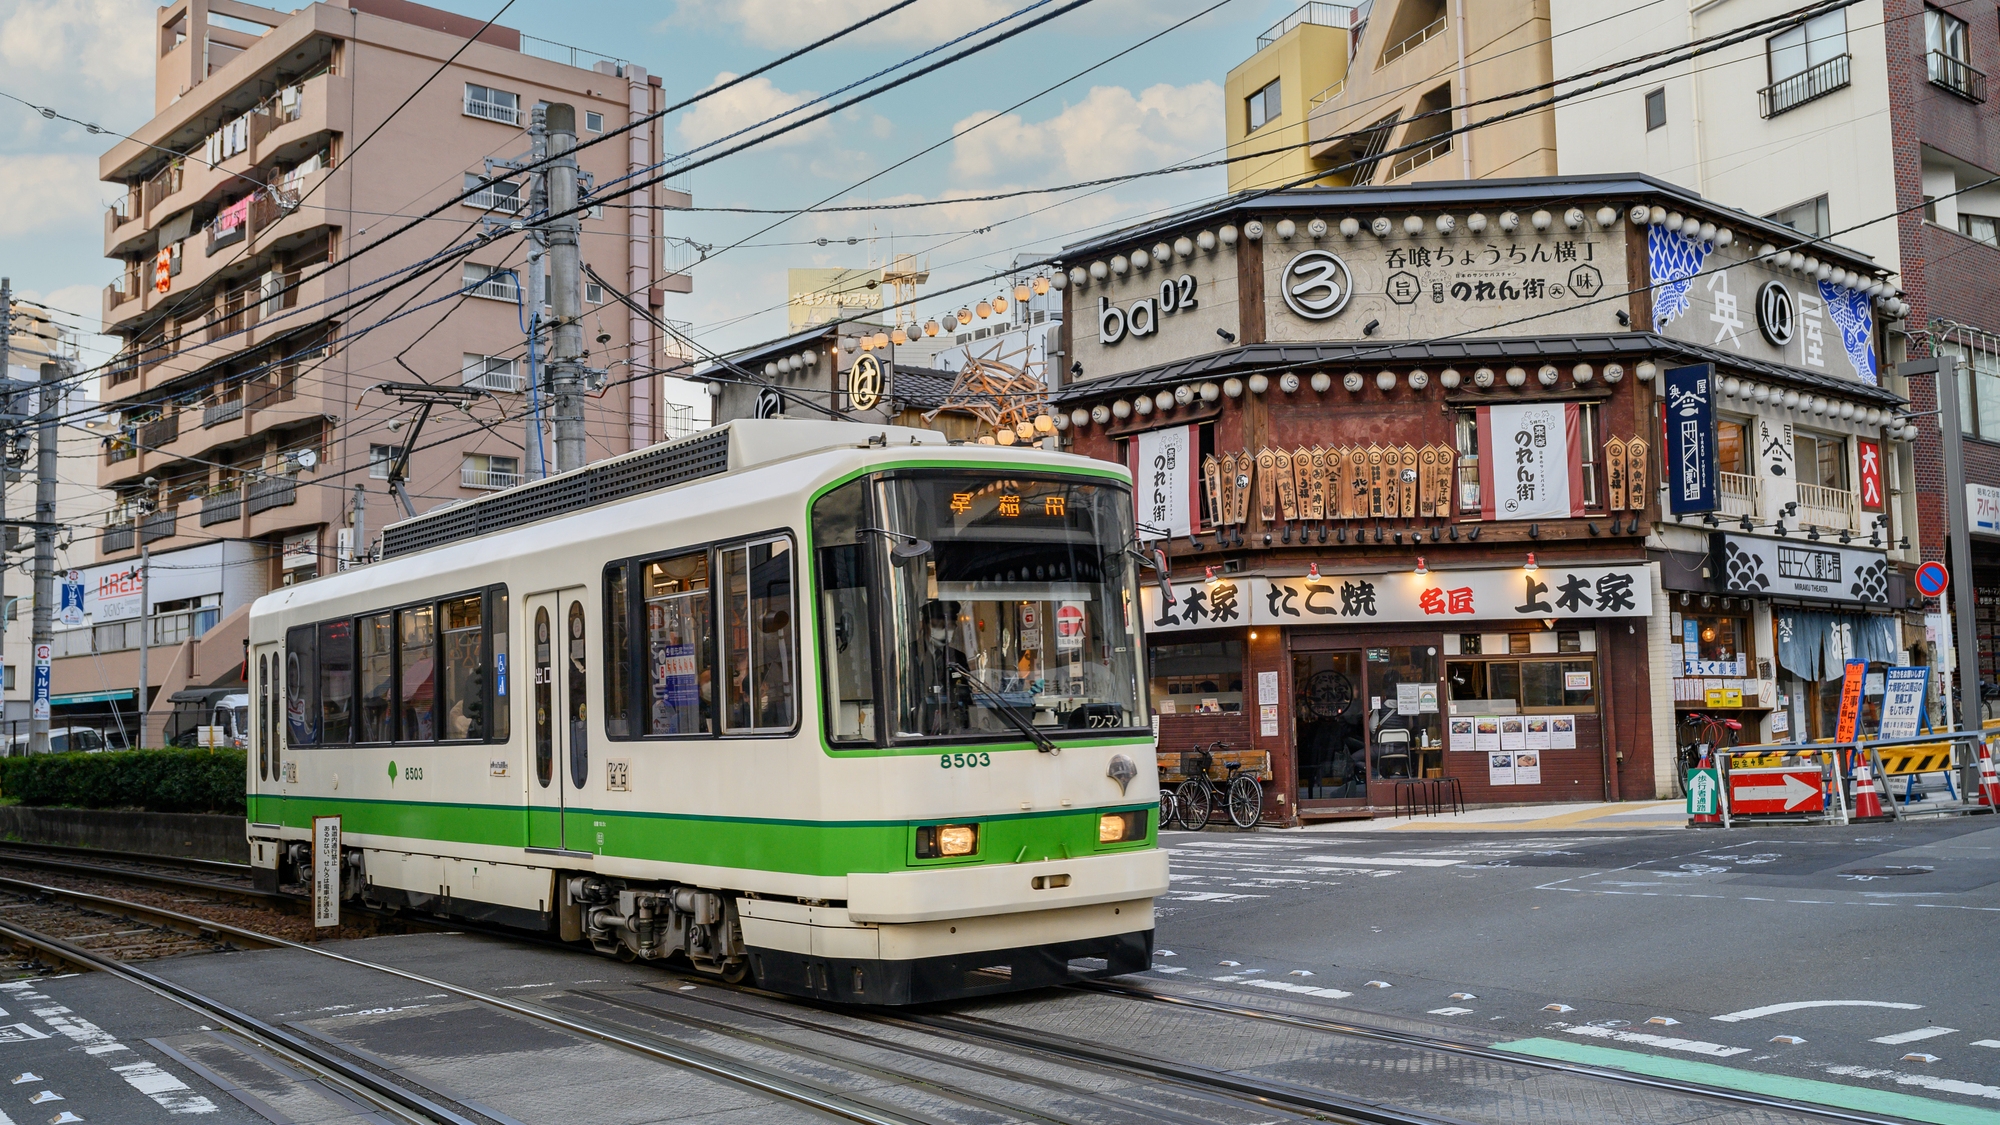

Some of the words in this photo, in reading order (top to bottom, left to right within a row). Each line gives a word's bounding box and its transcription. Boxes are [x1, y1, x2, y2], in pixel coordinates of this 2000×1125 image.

[1385, 241, 1601, 268] 呑喰ちょうちん横丁
[1394, 280, 1411, 297] 旨
[1451, 278, 1545, 301] のれん街
[1576, 272, 1594, 290] 味
[852, 358, 879, 406] は
[1515, 431, 1535, 501] のれん街
[1153, 455, 1166, 522] のれん街
[68, 585, 78, 606] マルヨ
[1266, 580, 1378, 617] たこ焼
[1419, 586, 1476, 615] 名匠
[1514, 573, 1636, 613] 上木家
[1794, 583, 1811, 591] MIRAKU
[1811, 584, 1829, 593] THEATER
[1154, 584, 1240, 627] 上木家
[1831, 621, 1853, 660] 酒
[536, 667, 552, 684] 出口
[1685, 661, 1737, 675] みらく劇場
[37, 666, 49, 698] マルヨ
[1089, 715, 1122, 729] ワンマン
[1838, 680, 1851, 743] ご協力お願い致し
[1846, 681, 1860, 743] 工事中につ
[608, 762, 628, 773] ワンマン
[940, 752, 991, 769] 8503
[1733, 759, 1748, 769] 安全
[405, 767, 424, 780] 8503
